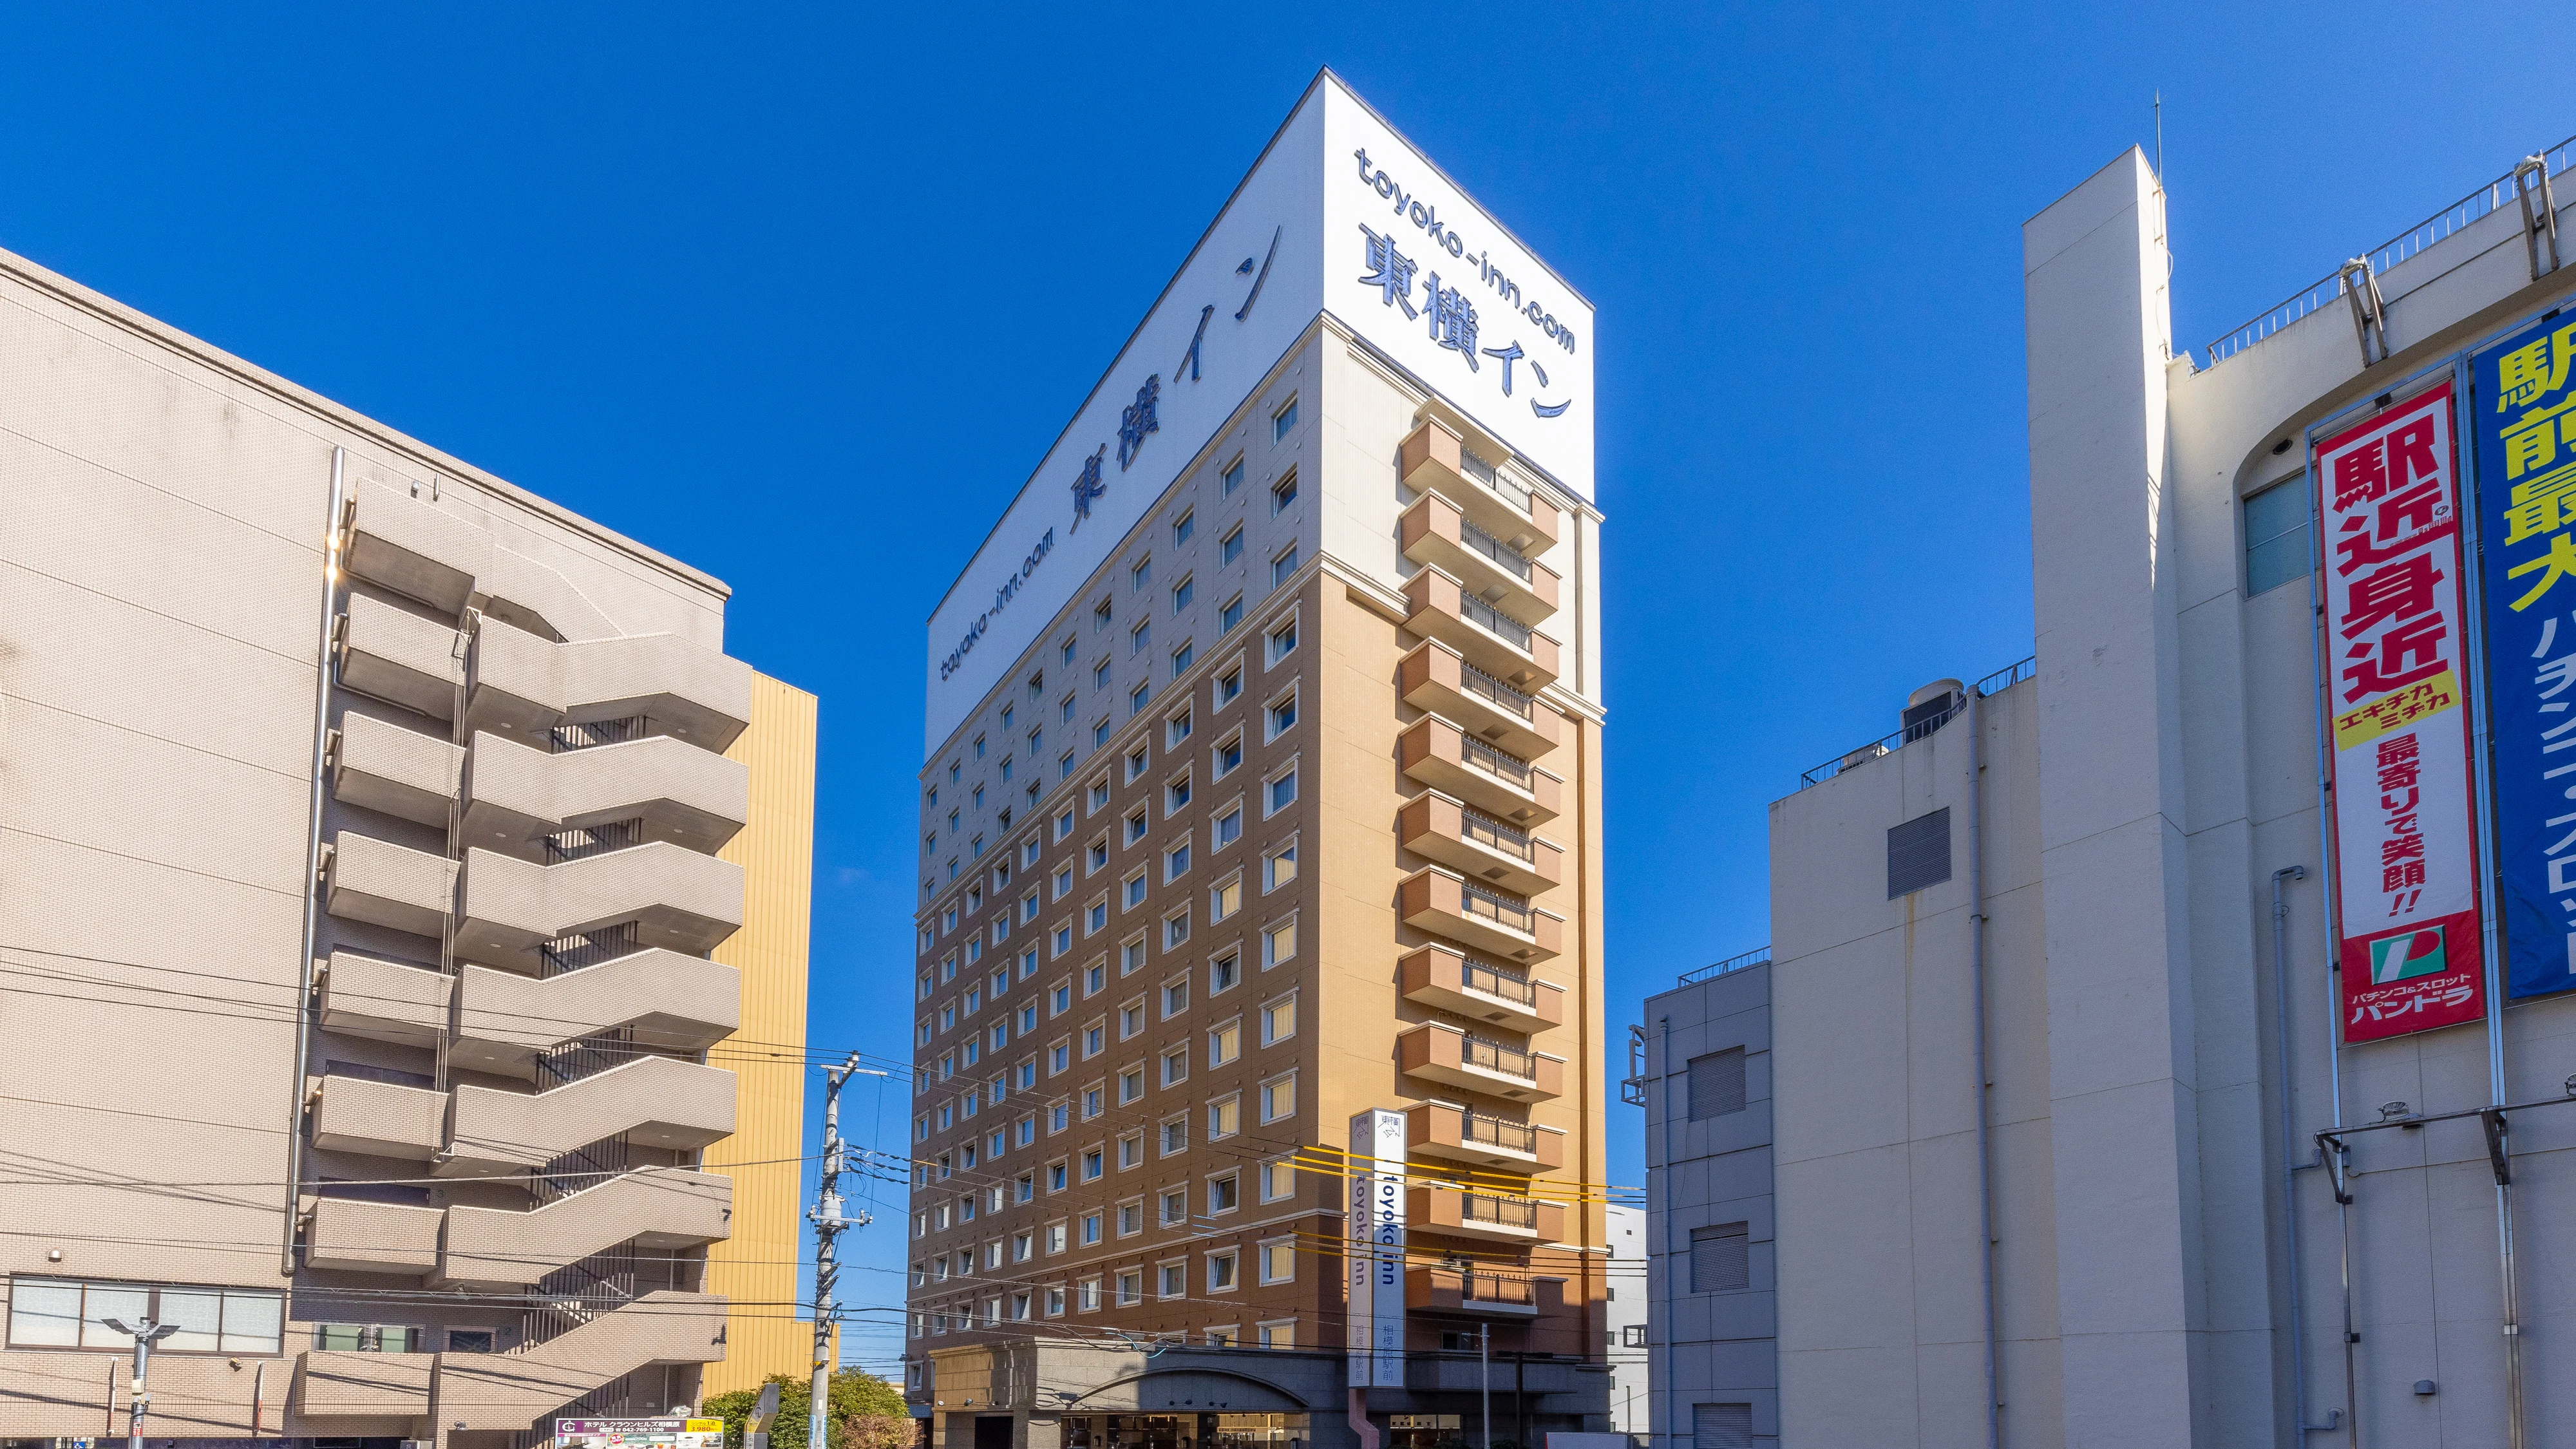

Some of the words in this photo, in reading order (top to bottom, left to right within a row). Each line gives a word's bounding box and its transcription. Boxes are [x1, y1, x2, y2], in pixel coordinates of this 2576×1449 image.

[1354, 147, 1575, 354] toyoko-inn.com
[1358, 222, 1571, 418] 東横イン
[1069, 224, 1282, 535] 東横イン
[940, 526, 1055, 682] toyoko-inn.com
[2339, 682, 2434, 732] エキチカ
[2351, 985, 2474, 1025] パンドラ
[2352, 973, 2471, 1005] パチンコ&スロット
[1379, 1175, 1399, 1246] toyoko
[1382, 1254, 1399, 1285] inn
[1382, 1324, 1394, 1381] 相模原駅前
